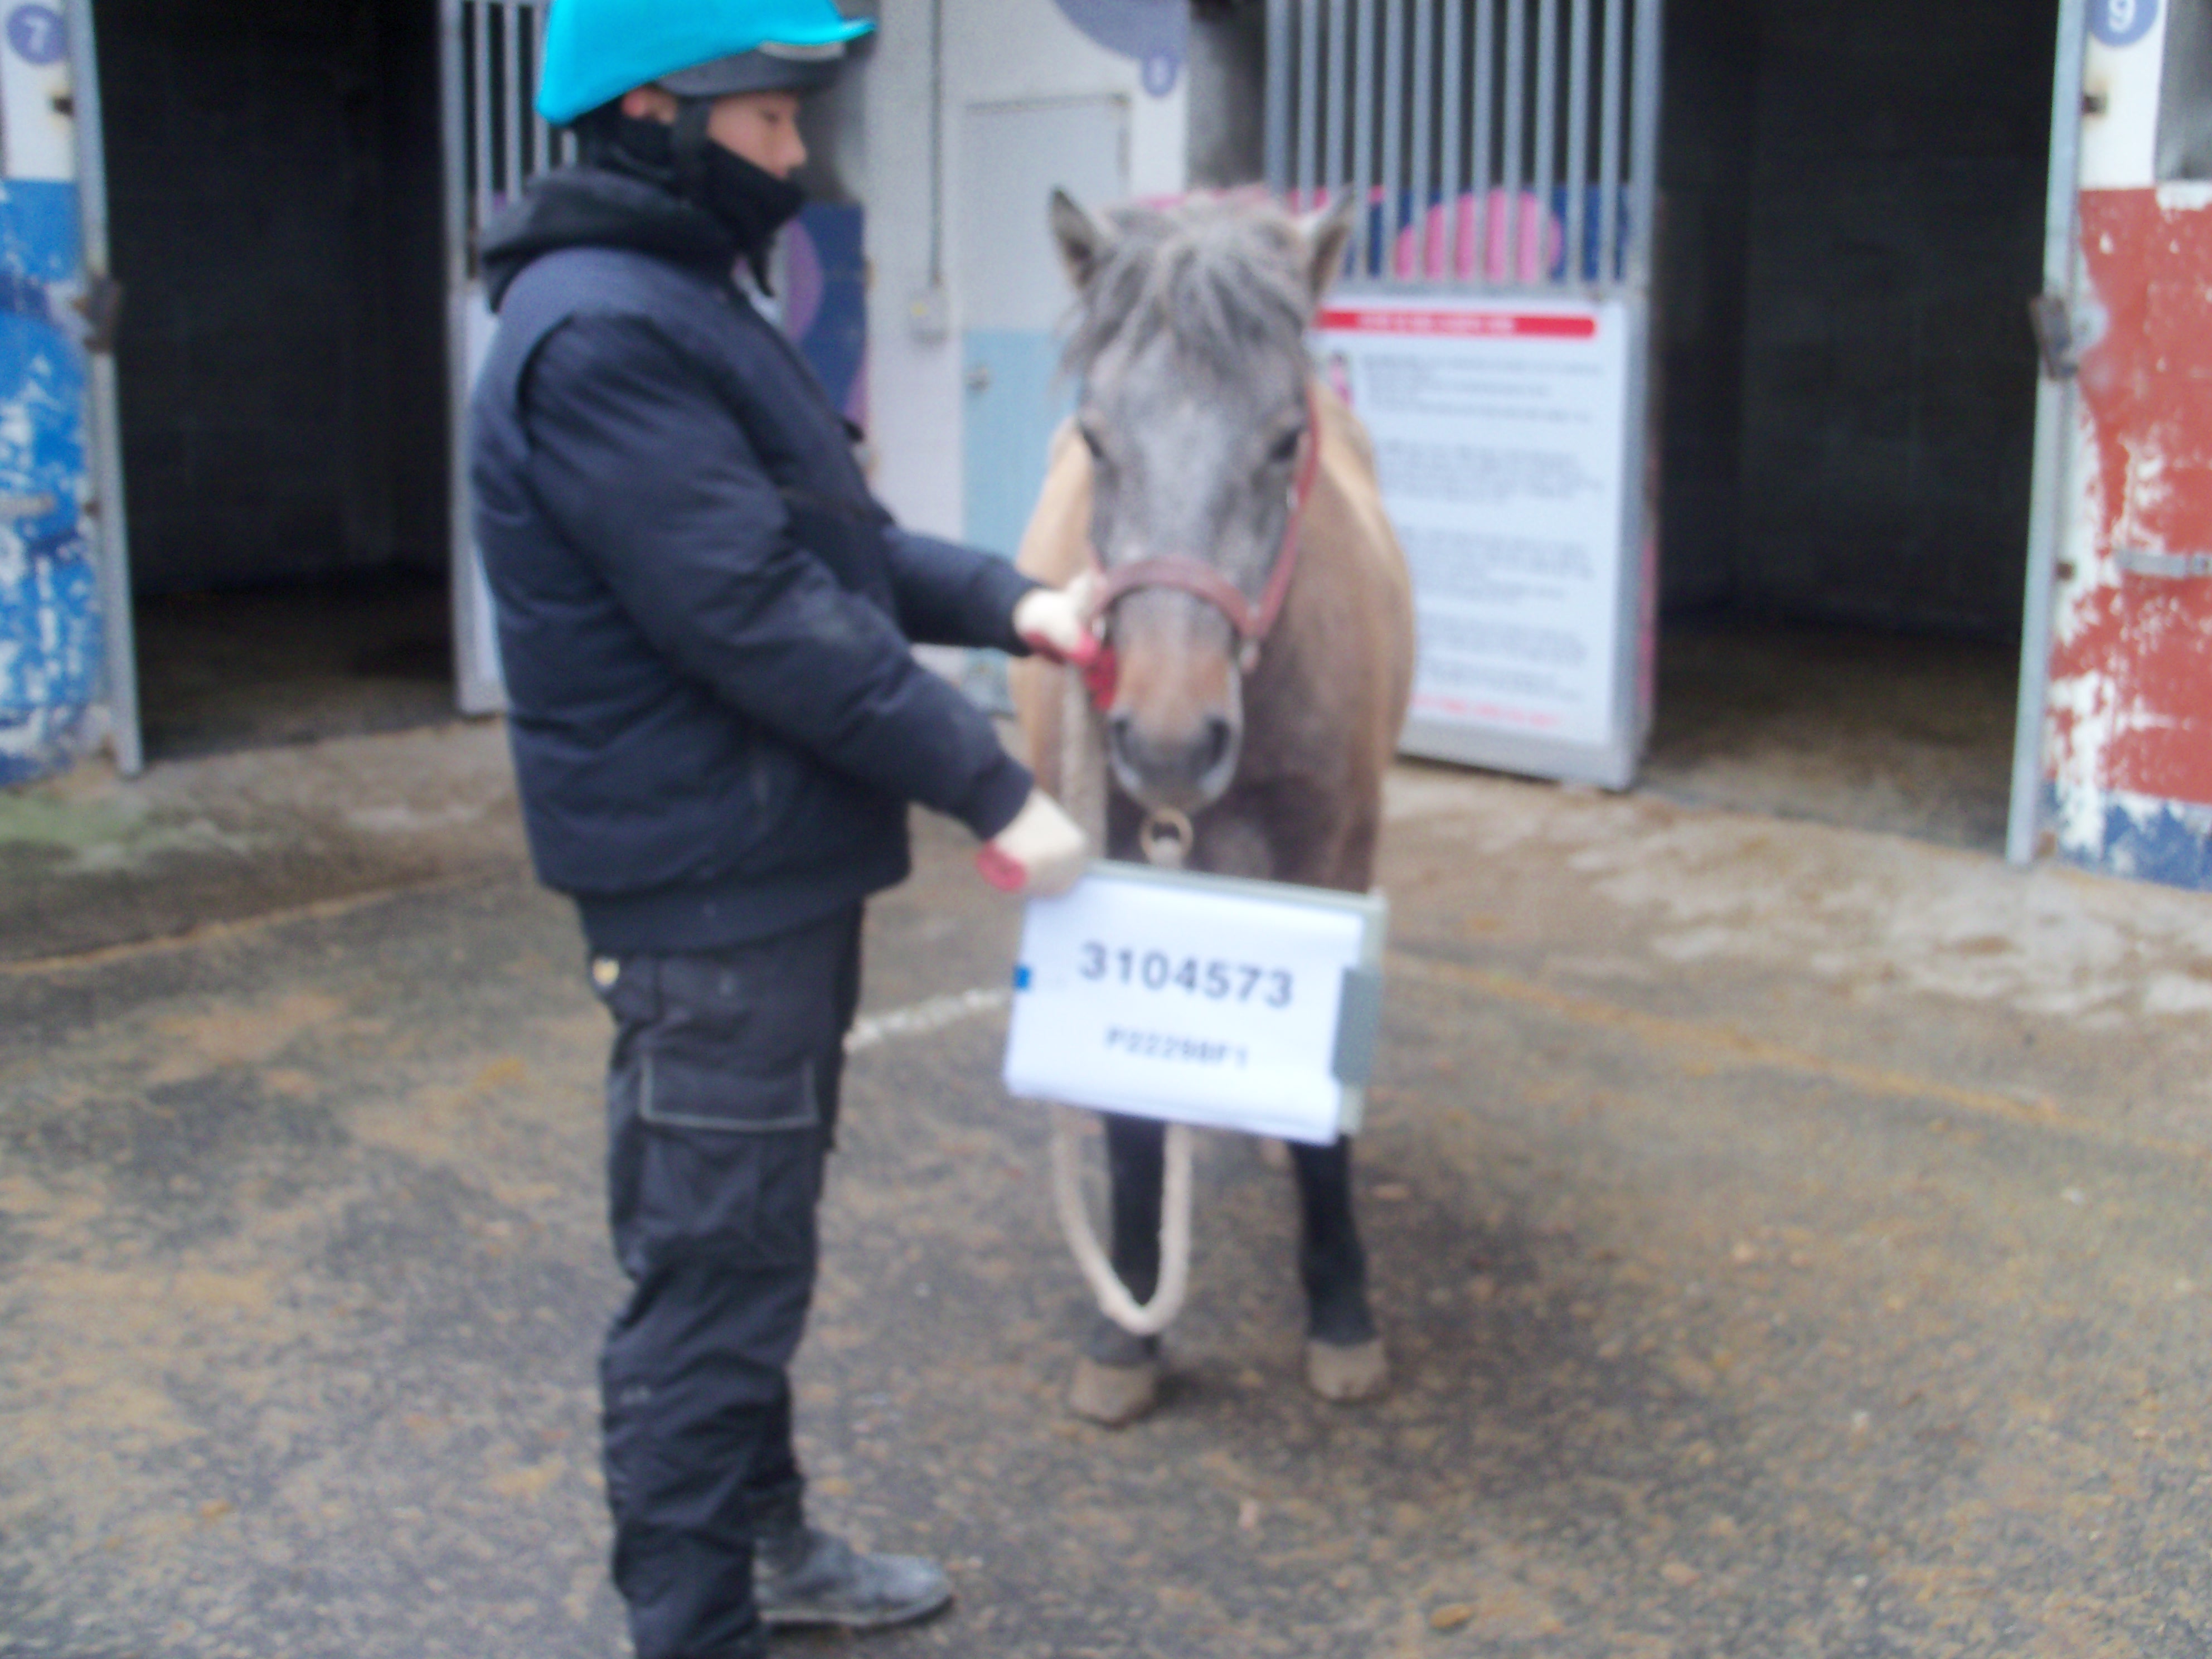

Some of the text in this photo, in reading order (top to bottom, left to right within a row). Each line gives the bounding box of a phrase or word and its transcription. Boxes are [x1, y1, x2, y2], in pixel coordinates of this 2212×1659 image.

[25, 16, 47, 55] 7
[2107, 0, 2135, 33] 9
[1078, 940, 1296, 1009] 3104573
